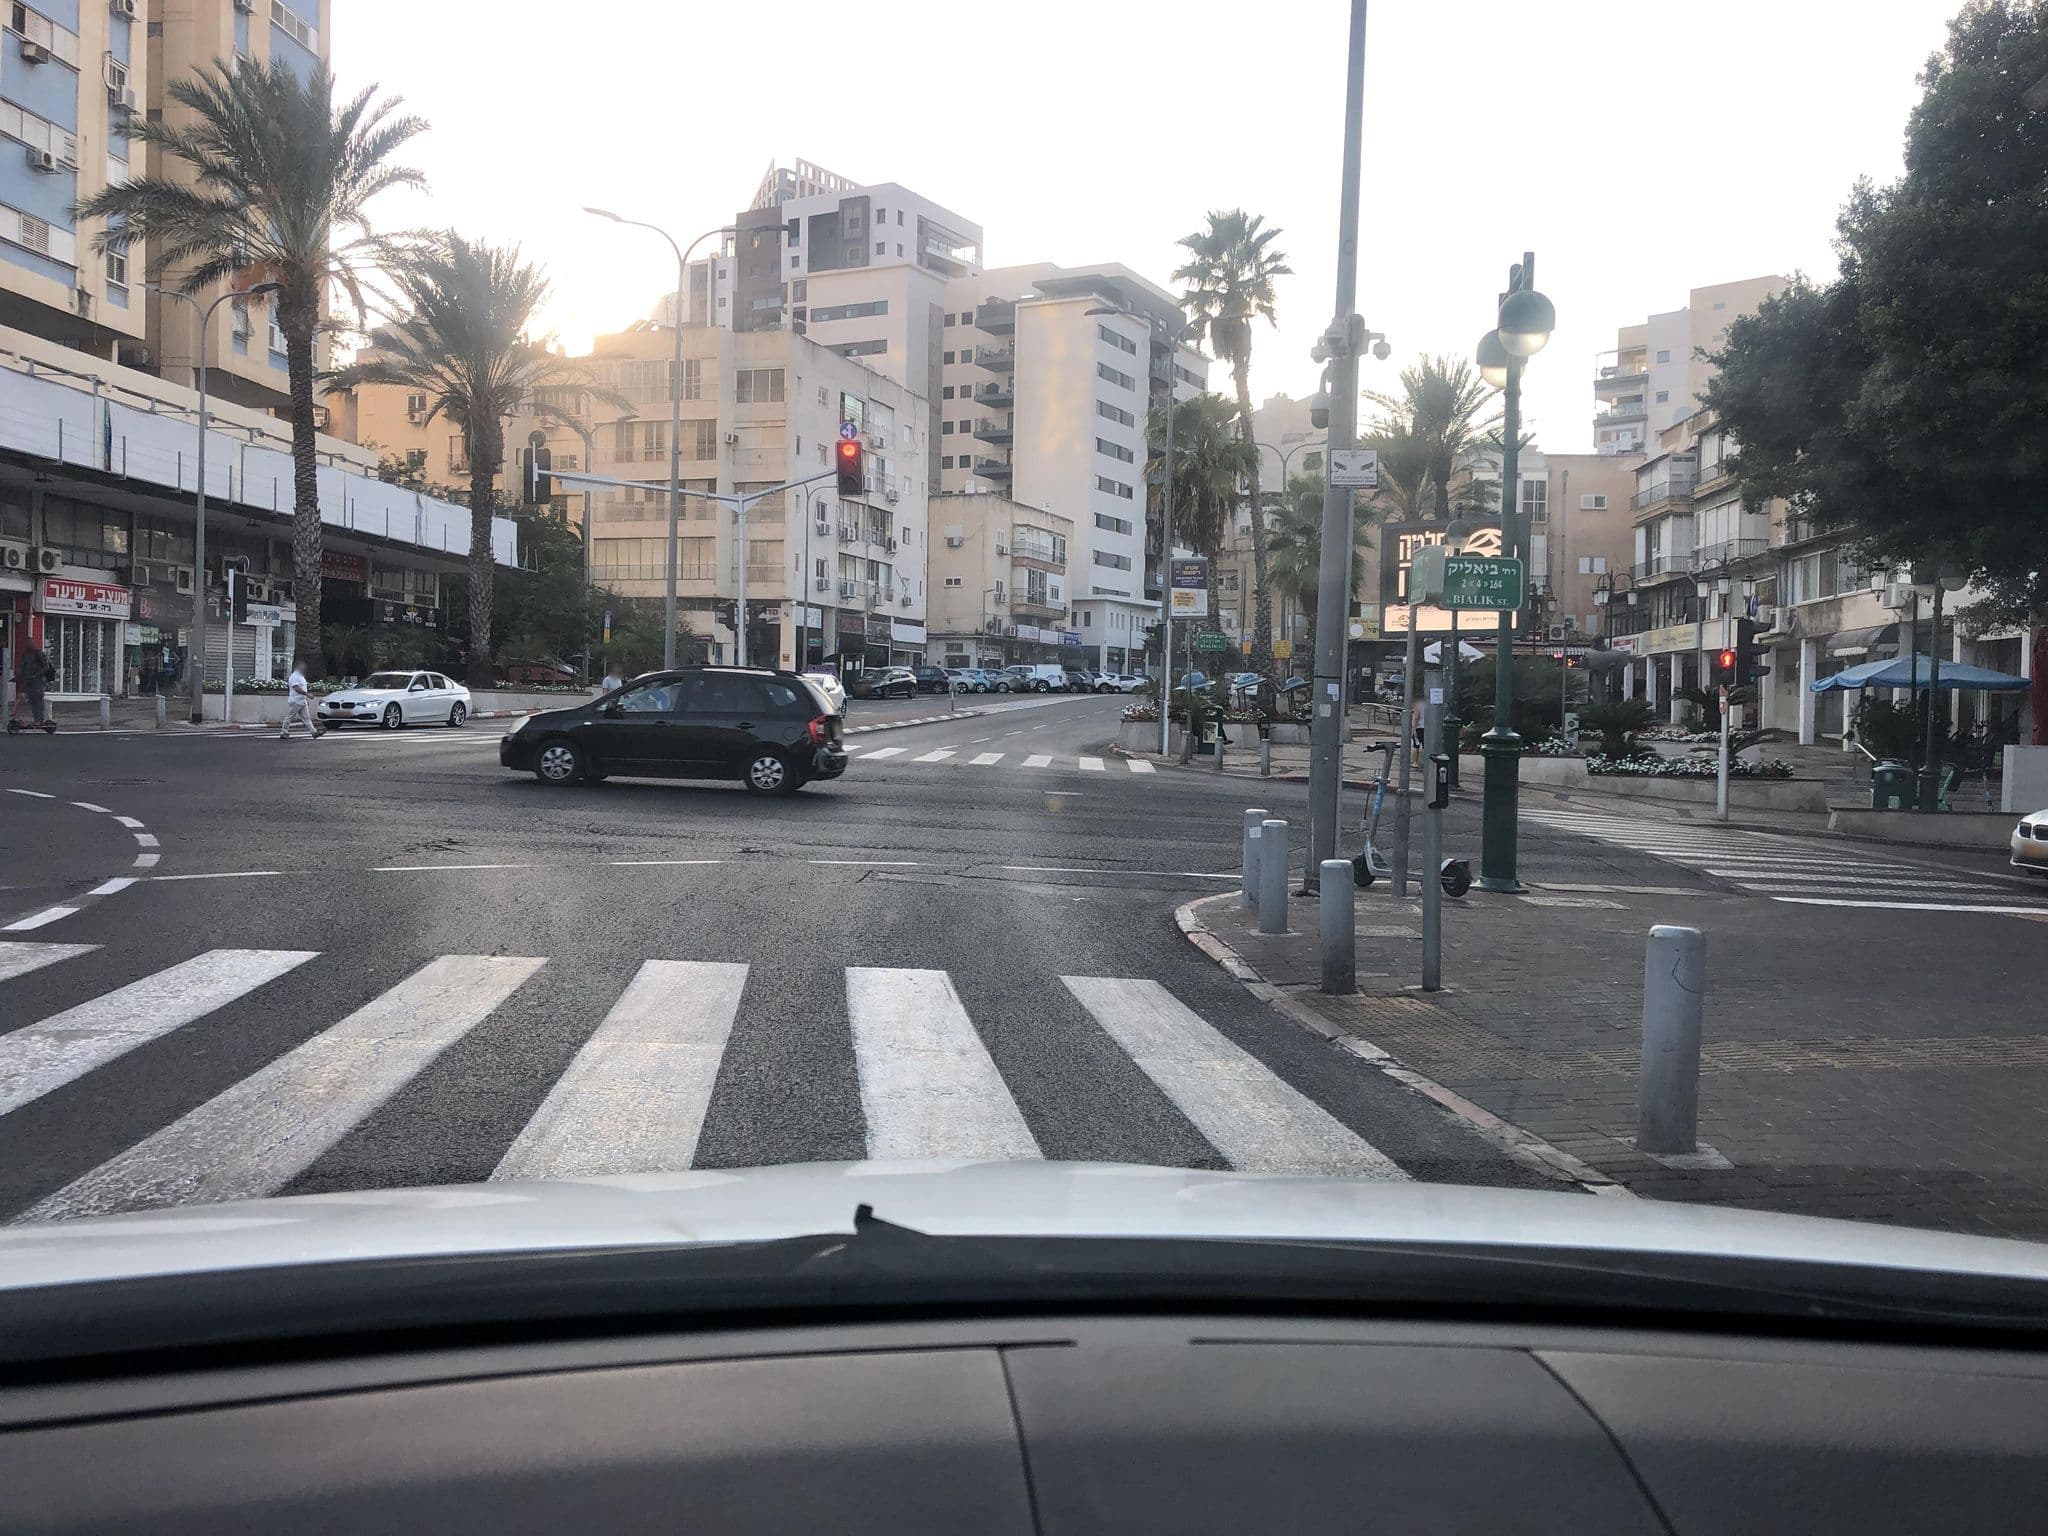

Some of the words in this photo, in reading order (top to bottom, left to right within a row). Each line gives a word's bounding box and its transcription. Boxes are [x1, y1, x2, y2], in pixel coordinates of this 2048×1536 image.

[1447, 560, 1499, 577] ביאליק
[49, 584, 86, 600] שיער
[93, 588, 128, 605] מעצבי
[1453, 594, 1495, 606] BIALIK
